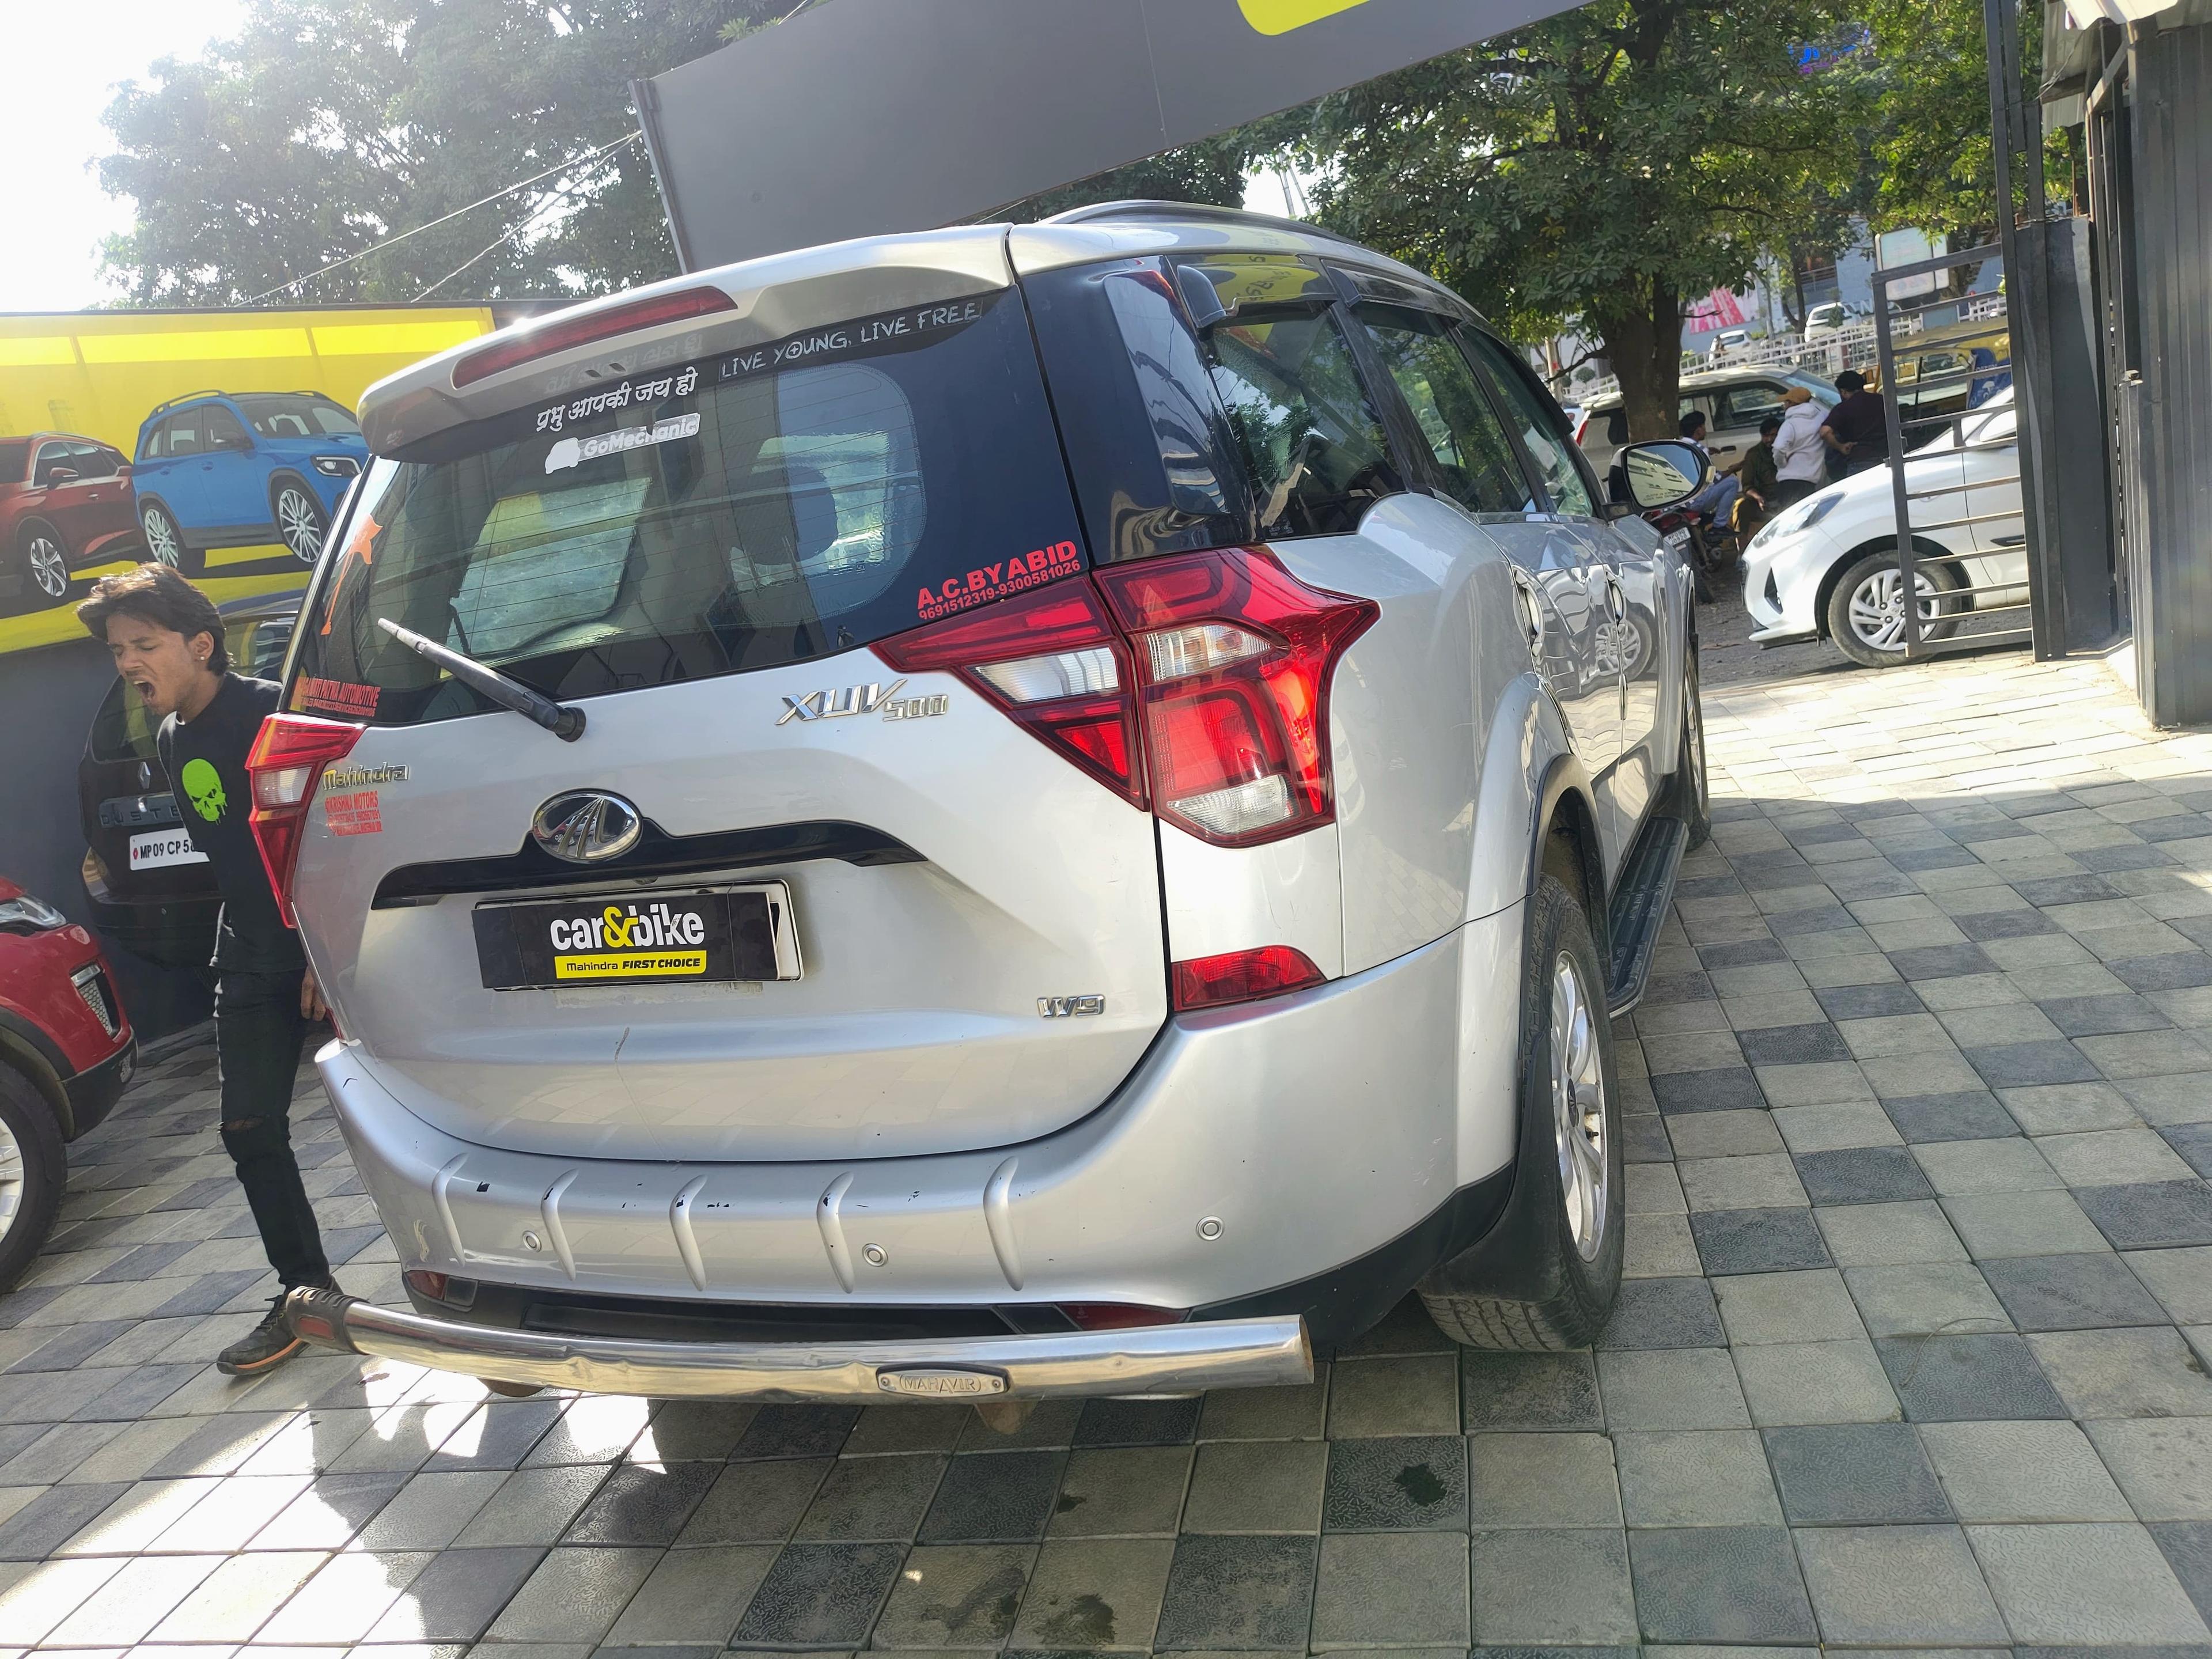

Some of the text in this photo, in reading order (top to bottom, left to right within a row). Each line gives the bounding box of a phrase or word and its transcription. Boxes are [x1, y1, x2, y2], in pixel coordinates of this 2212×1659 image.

[721, 352, 766, 378] LIVE
[861, 317, 911, 342] LIVE
[917, 302, 981, 329] FREE
[536, 365, 704, 432] प्रभु आपकी जय हो
[918, 559, 1081, 620] 9691512319-9300581026
[324, 762, 408, 790] Mahindra
[354, 790, 378, 810] MOTORS
[101, 805, 180, 825] DUSTE
[550, 903, 704, 950] car&bike
[566, 957, 700, 971] Mahindra FIRST CHOICE
[1037, 994, 1104, 1018] W9
[903, 1376, 976, 1394] MAHAVIR
